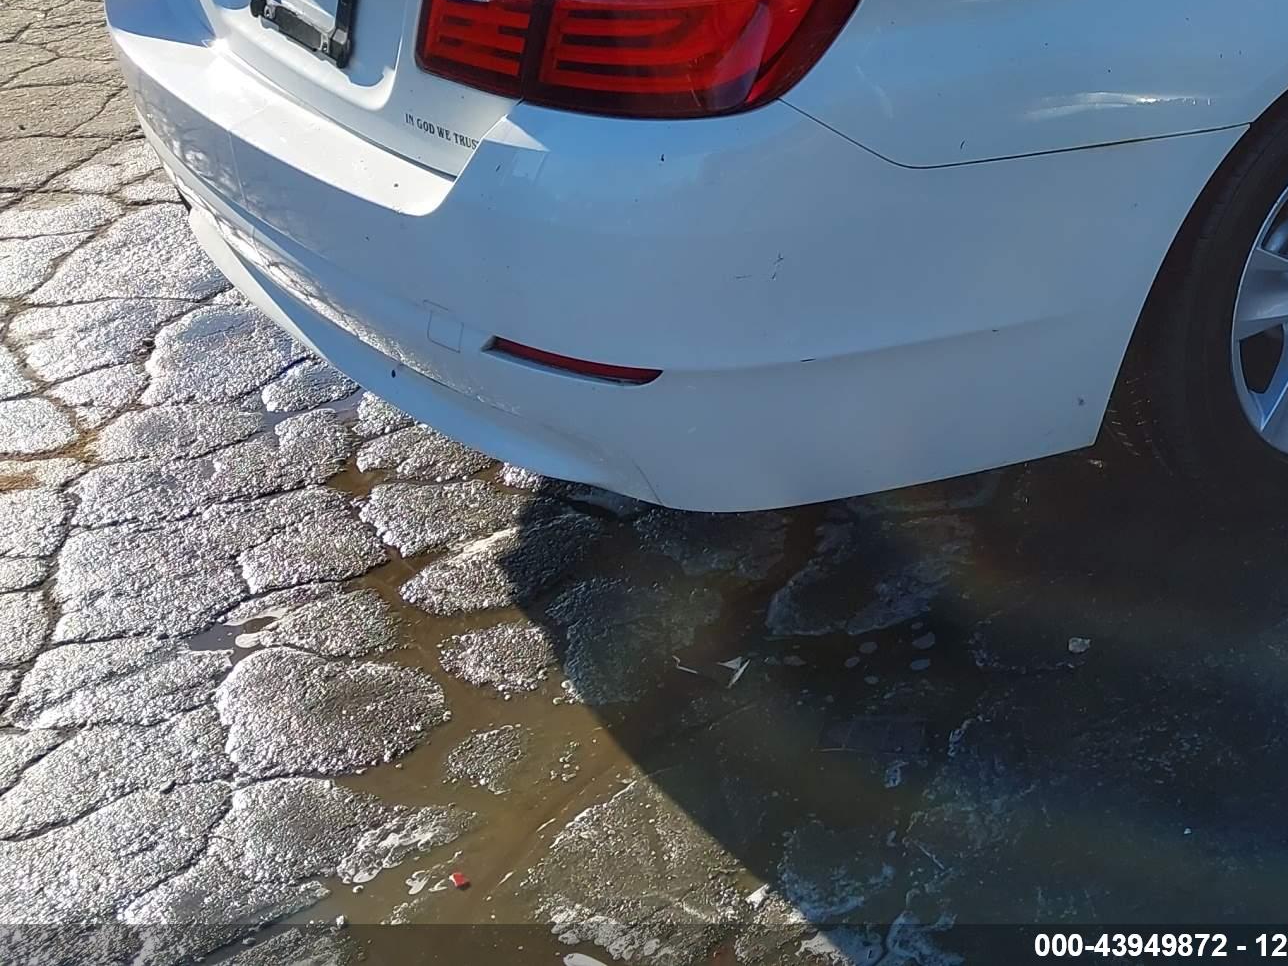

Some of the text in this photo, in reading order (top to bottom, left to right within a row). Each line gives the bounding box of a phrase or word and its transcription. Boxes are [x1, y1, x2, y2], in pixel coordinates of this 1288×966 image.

[405, 113, 414, 126] IN
[416, 118, 435, 135] GOD
[436, 126, 451, 141] WE
